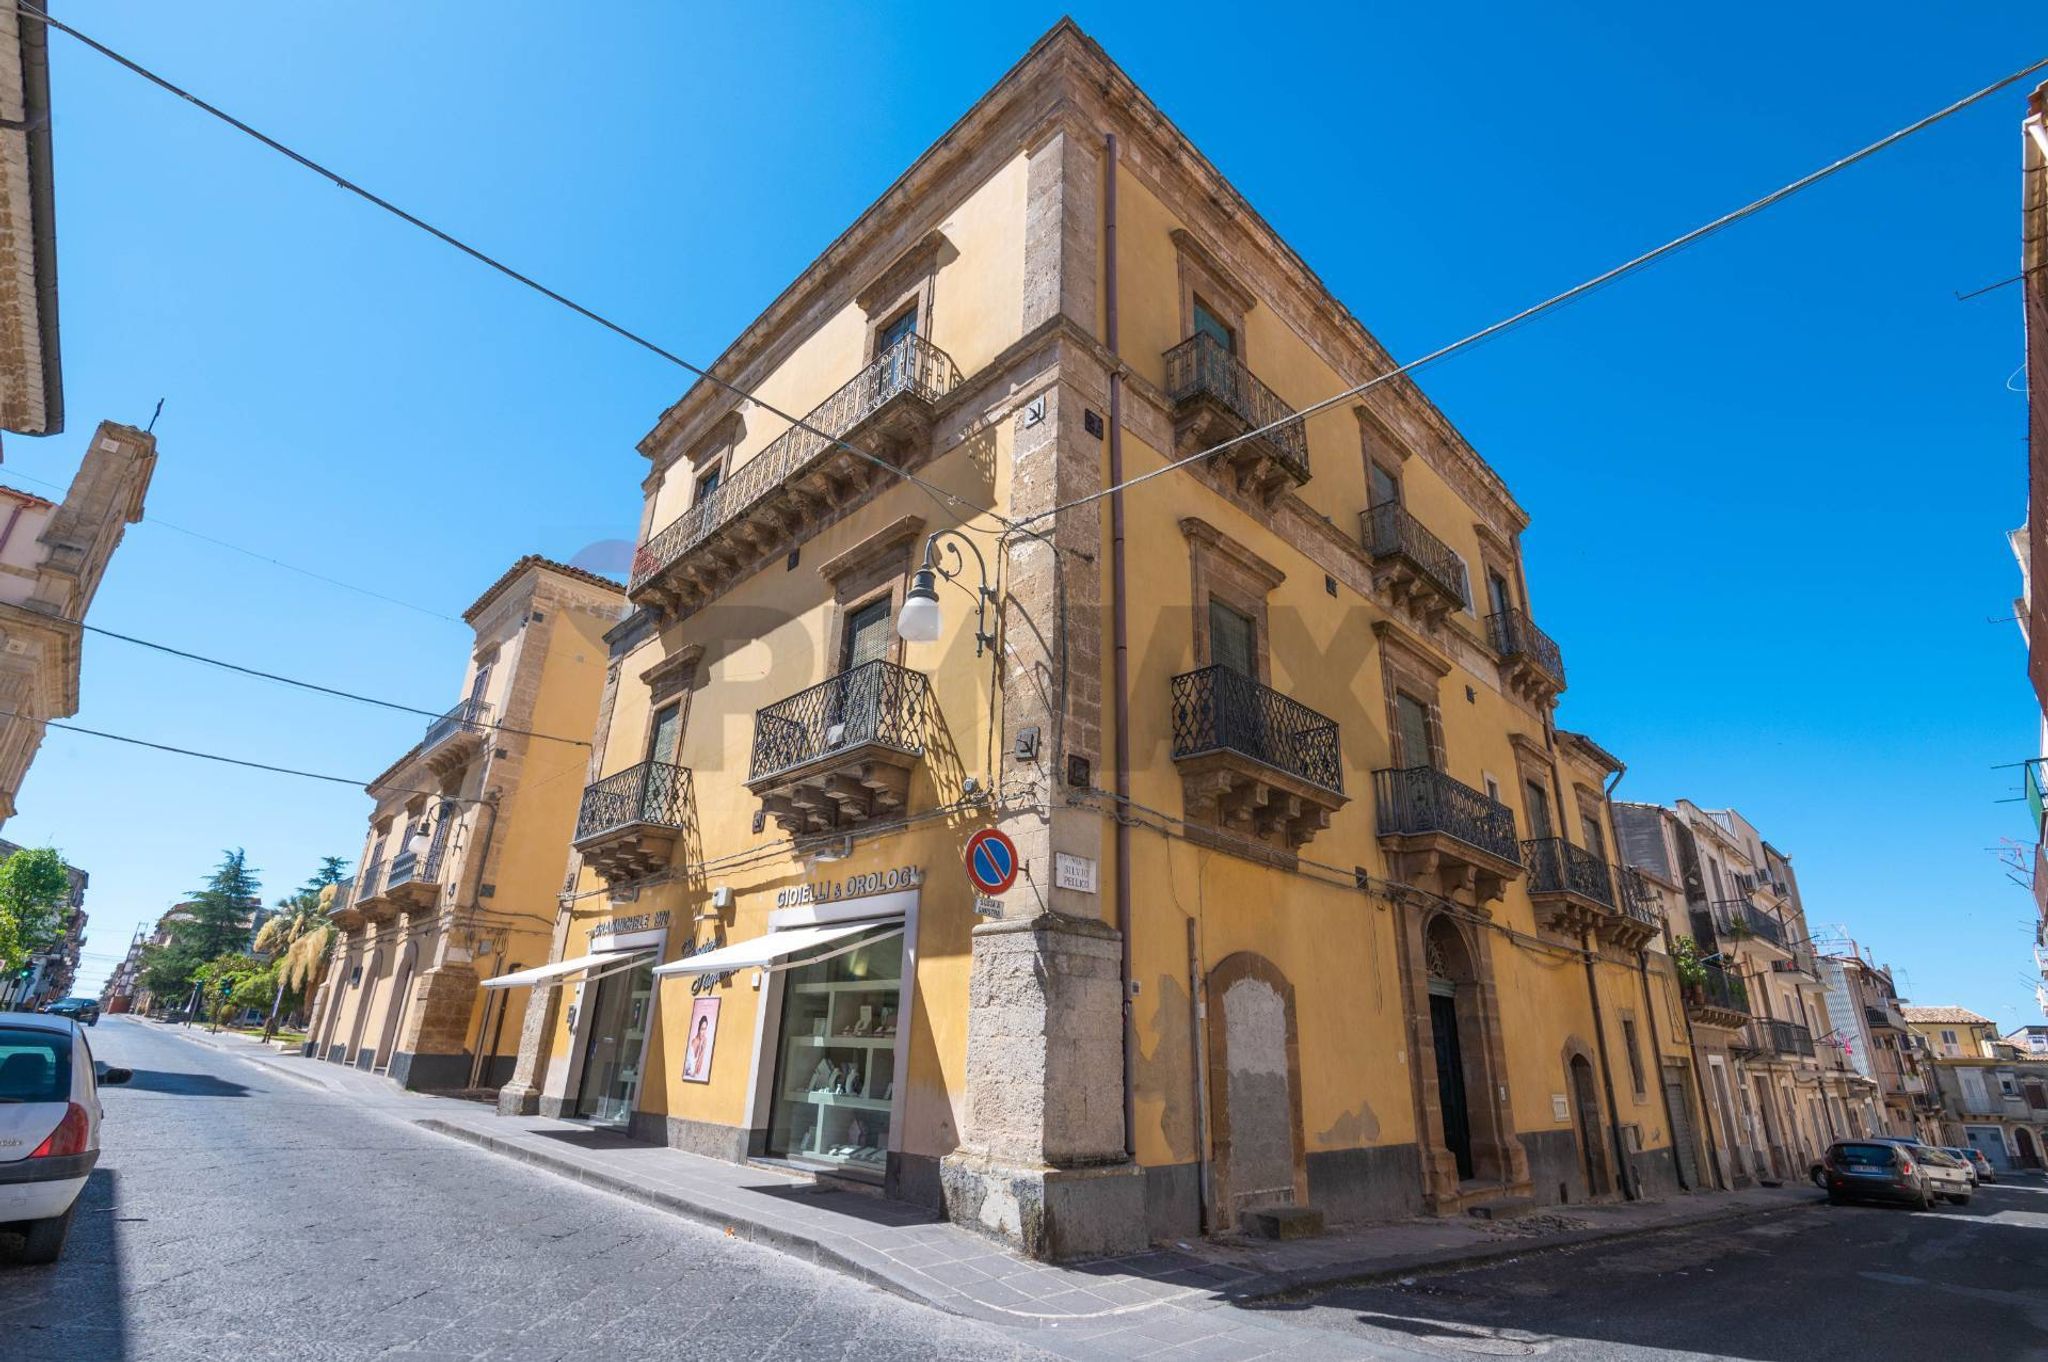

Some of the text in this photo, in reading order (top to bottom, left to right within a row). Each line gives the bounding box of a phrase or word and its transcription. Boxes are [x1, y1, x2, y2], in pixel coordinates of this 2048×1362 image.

[1064, 865, 1090, 878] SILVIO
[1063, 876, 1090, 889] PELLICO
[777, 879, 831, 909] GIOIELLI
[834, 882, 842, 899] &
